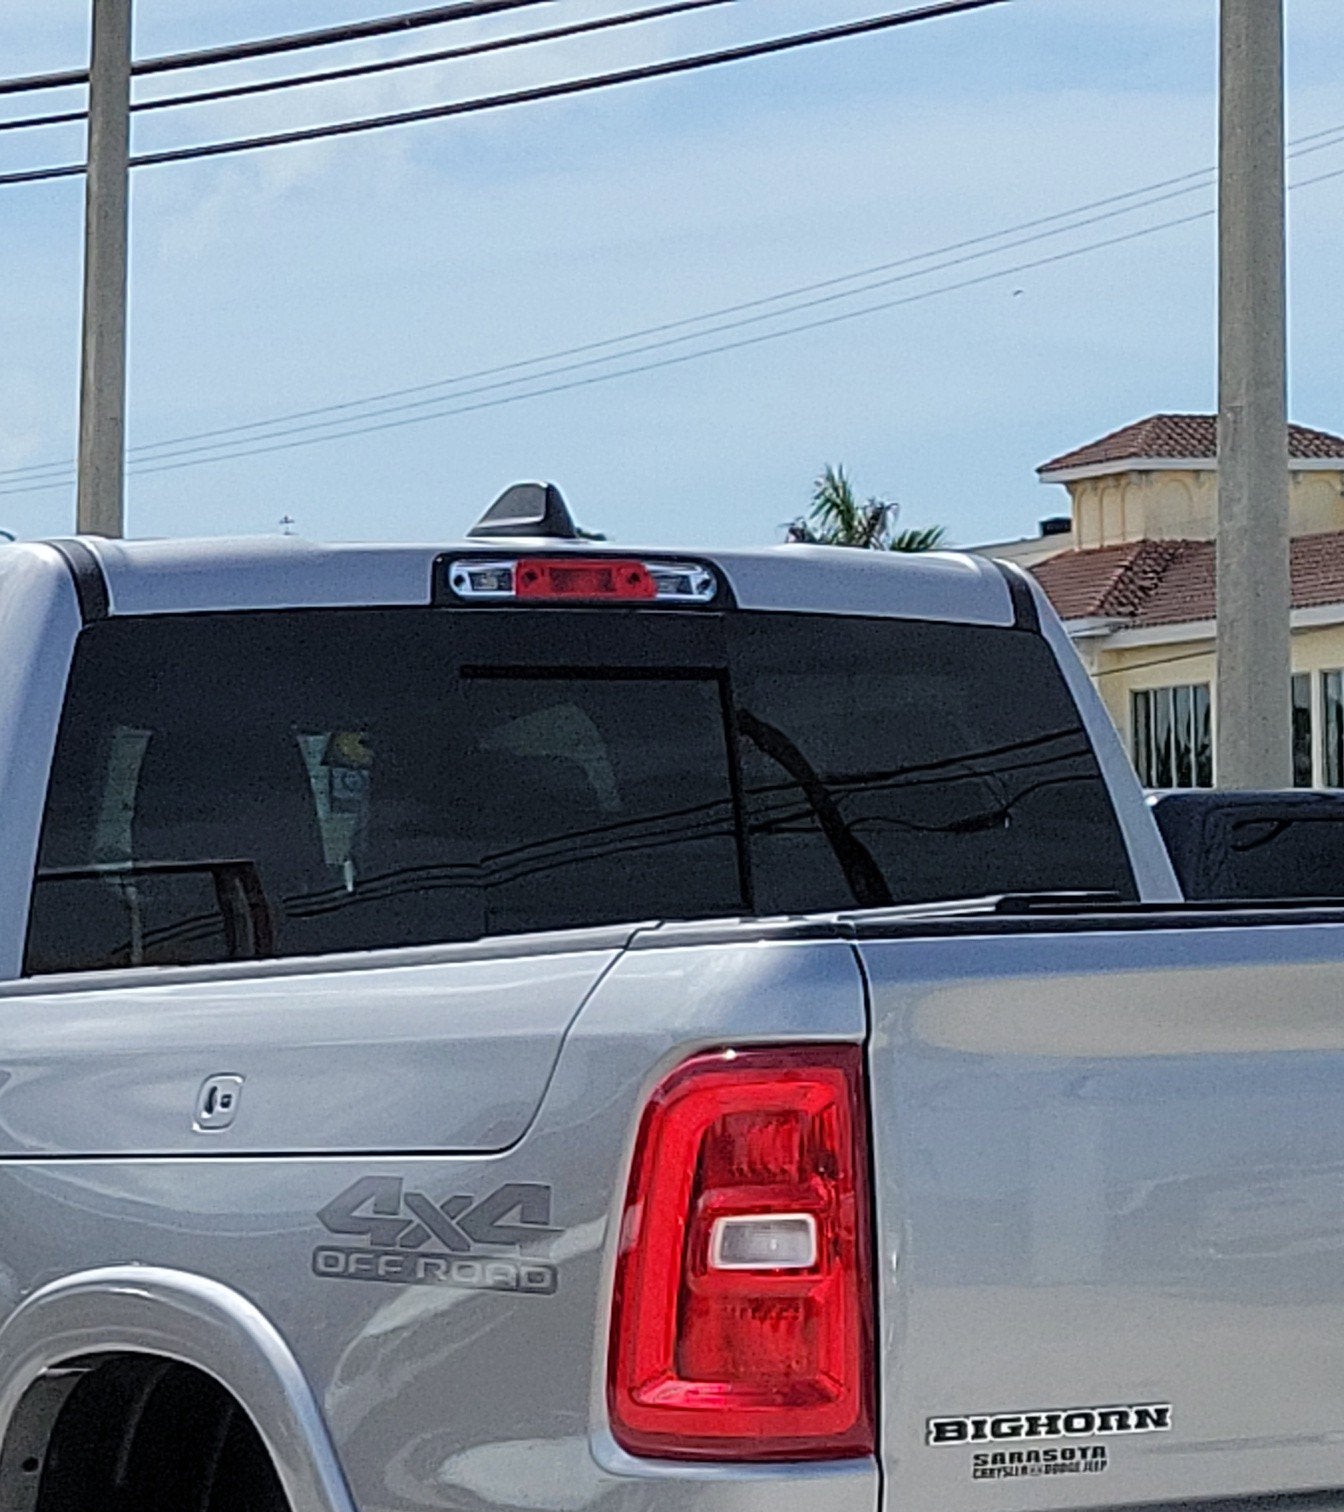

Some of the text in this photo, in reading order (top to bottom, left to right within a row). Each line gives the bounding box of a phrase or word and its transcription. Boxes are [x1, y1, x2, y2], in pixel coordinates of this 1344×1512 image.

[316, 1176, 565, 1259] 4x4
[316, 1250, 555, 1289] OFF ROAD
[928, 1403, 1172, 1444] BIGHORN
[973, 1445, 1107, 1467] SARASOTA
